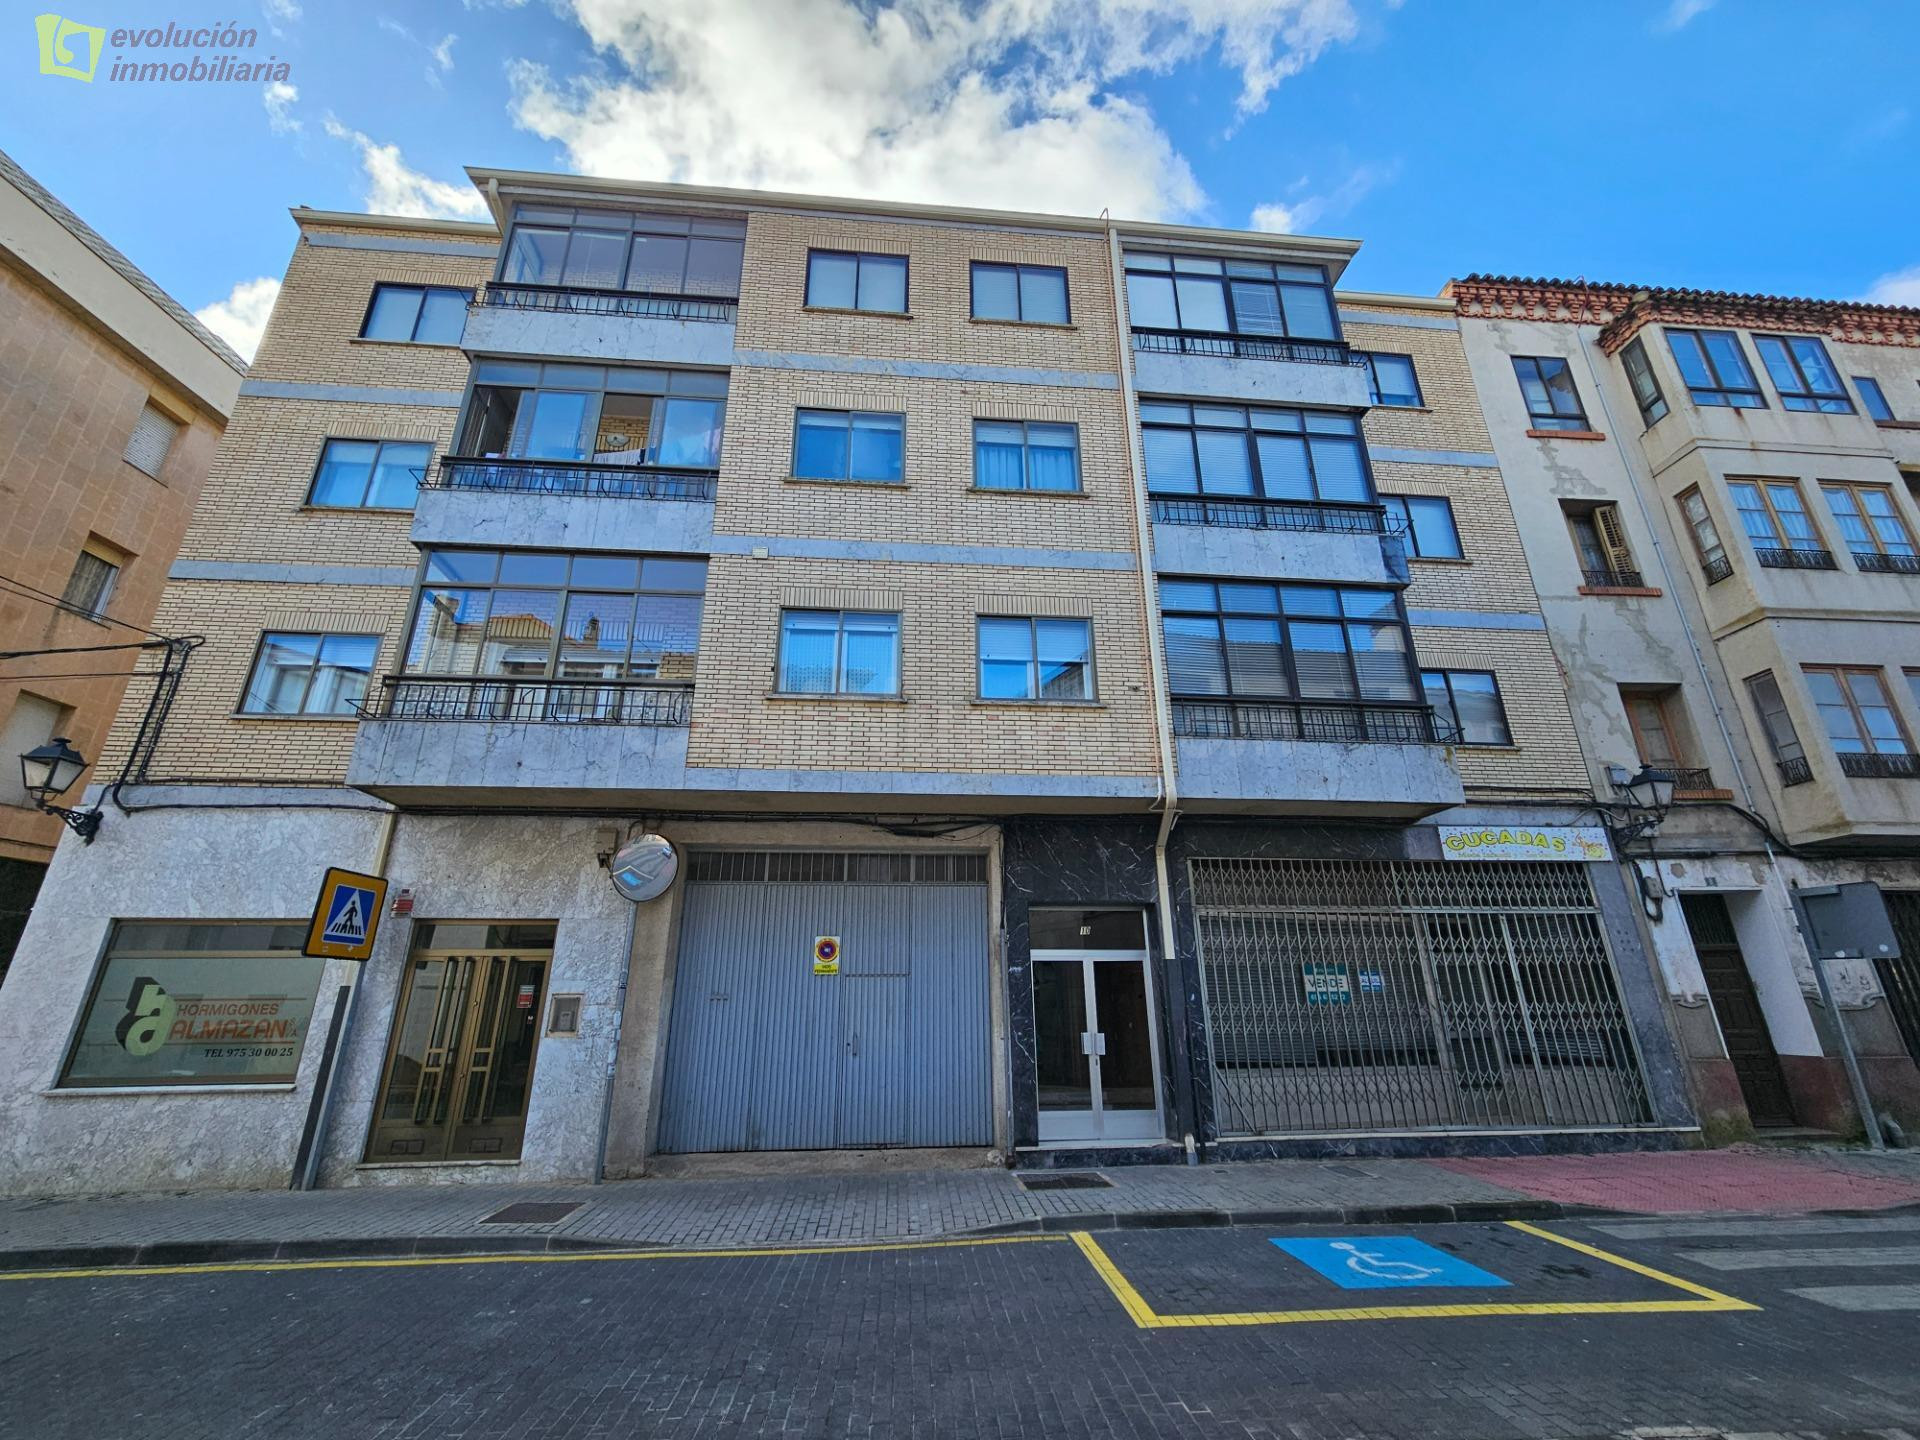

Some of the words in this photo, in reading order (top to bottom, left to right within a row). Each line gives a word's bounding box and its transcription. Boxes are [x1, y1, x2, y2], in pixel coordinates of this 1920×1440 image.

[1445, 830, 1566, 852] CUCADAS
[1307, 978, 1344, 988] VENDE
[176, 1003, 280, 1016] HORMIGONES
[169, 1018, 289, 1039] ALMAZAN
[204, 1048, 225, 1058] TEL
[226, 1048, 247, 1057] 975
[248, 1048, 262, 1057] 30
[264, 1047, 278, 1057] 00
[279, 1047, 294, 1056] 25
